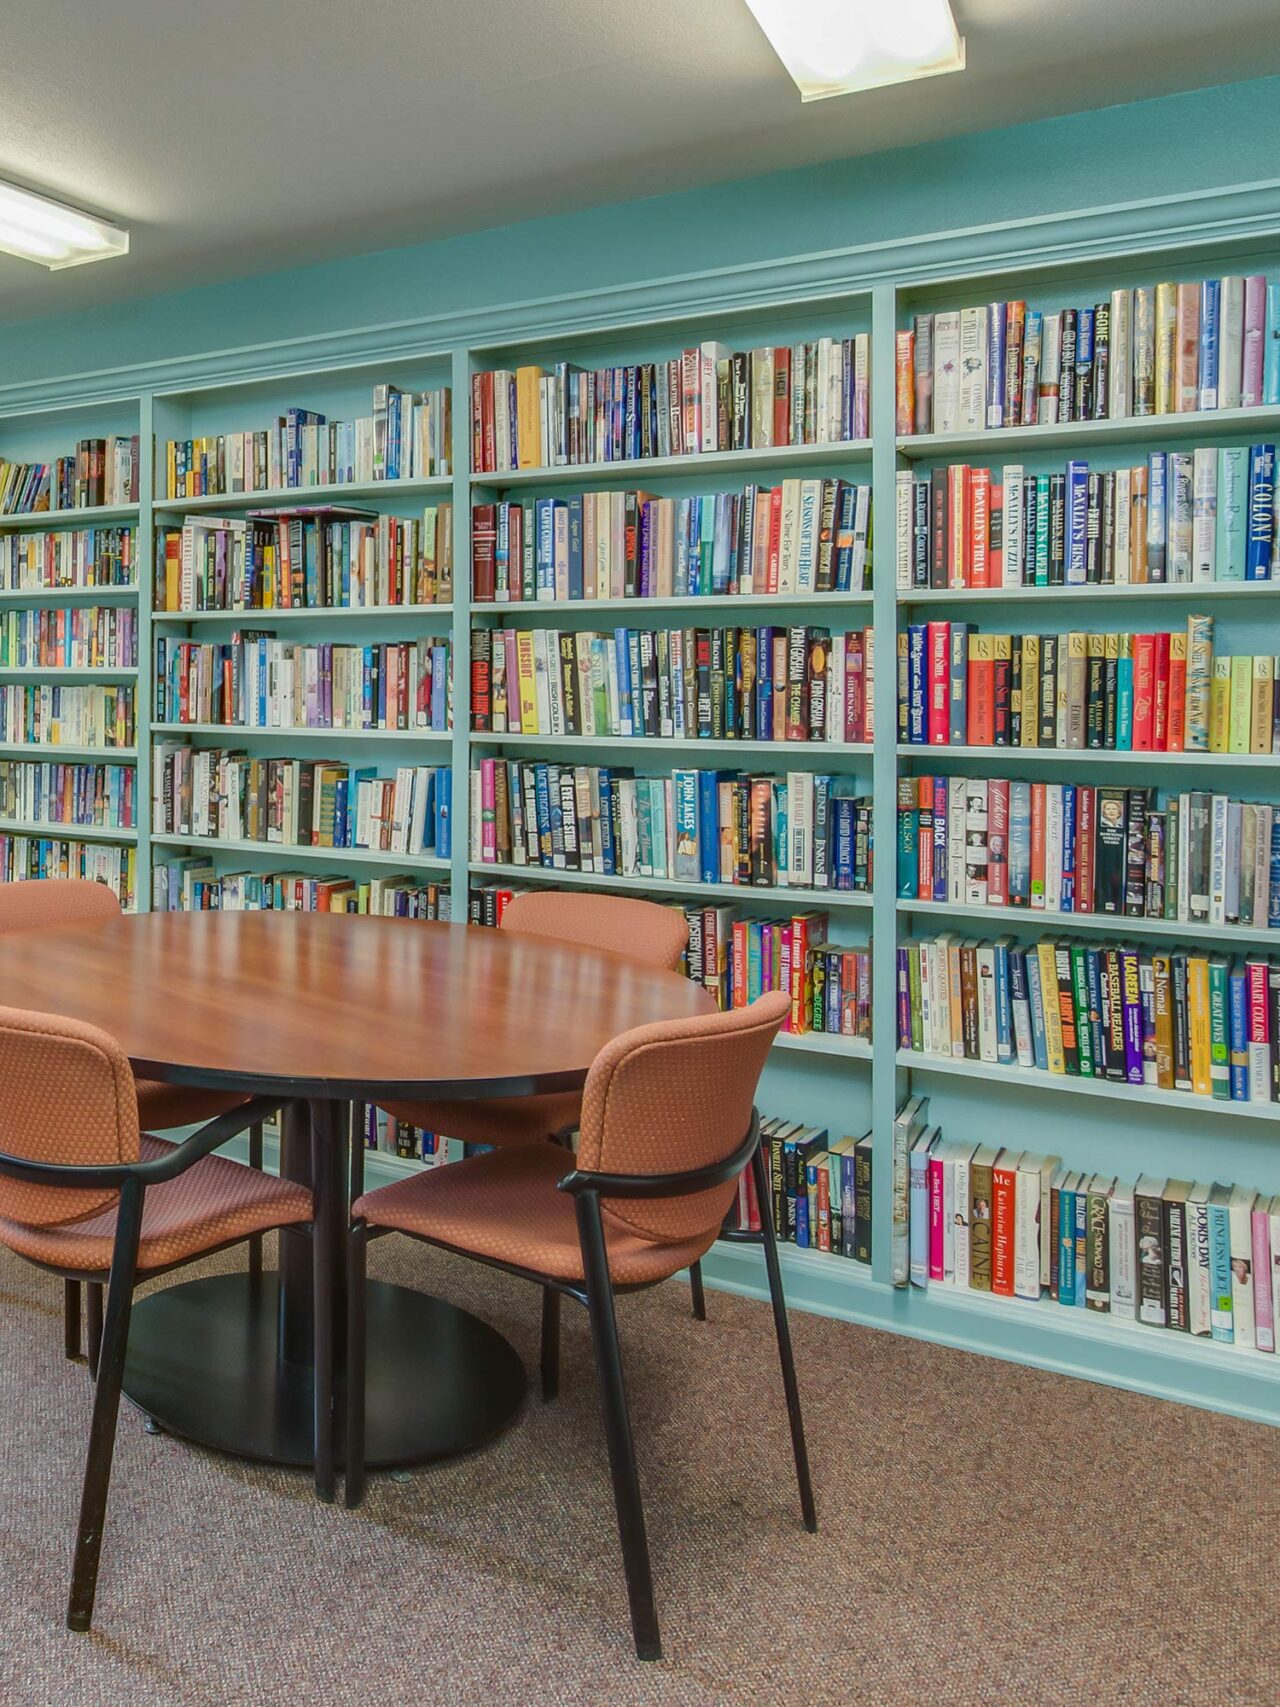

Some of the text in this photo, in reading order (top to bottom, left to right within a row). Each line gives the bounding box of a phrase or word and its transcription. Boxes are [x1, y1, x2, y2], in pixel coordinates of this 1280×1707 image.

[1096, 311, 1109, 341] GONE
[783, 523, 793, 540] Time
[784, 509, 793, 522] No
[1252, 484, 1273, 543] COLONY
[783, 540, 792, 552] For
[800, 542, 812, 558] THE
[801, 531, 813, 541] OF
[797, 559, 812, 586] HEART
[974, 543, 984, 574] TRIAL
[1008, 539, 1018, 575] PUZZLE
[1036, 544, 1048, 576] CAPER
[1072, 543, 1083, 569] RISK
[712, 640, 721, 670] BROKER
[790, 628, 805, 648] JOHN
[519, 637, 533, 679] LONGSHOT
[789, 648, 804, 681] GRISHAM
[472, 661, 489, 715] GRAND JURY
[811, 680, 824, 728] JOHN GRISHAM
[551, 702, 559, 722] GOLD
[537, 769, 549, 828] JACK HIGGINS
[683, 775, 694, 830] JOHN JAKES
[934, 788, 945, 846] FIGHT BACK
[815, 784, 827, 873] SILENCED JENKINS
[903, 812, 913, 854] COLSON
[686, 916, 702, 979] MYSTERY WALK
[780, 963, 791, 993] EVANOVIC
[1123, 956, 1139, 1005] KAREEM
[1251, 967, 1264, 1007] PRIMARY
[813, 997, 822, 1029] DEGREE
[1055, 951, 1076, 1048] DRIVE LARRY BIRD
[1109, 963, 1124, 1051] BASEBALL READER
[1155, 979, 1168, 1016] Nomad
[1212, 991, 1223, 1042] GREAT LIVES
[1252, 1008, 1265, 1042] COLORS
[772, 1140, 783, 1192] DANIELLE STEEL
[787, 1197, 797, 1226] JENKINS
[971, 1222, 990, 1281] CAINE
[995, 1190, 1008, 1278] Katharine Hepburn
[1090, 1196, 1106, 1270] GRACE MONACO
[1197, 1207, 1210, 1269] DORIS DAY
